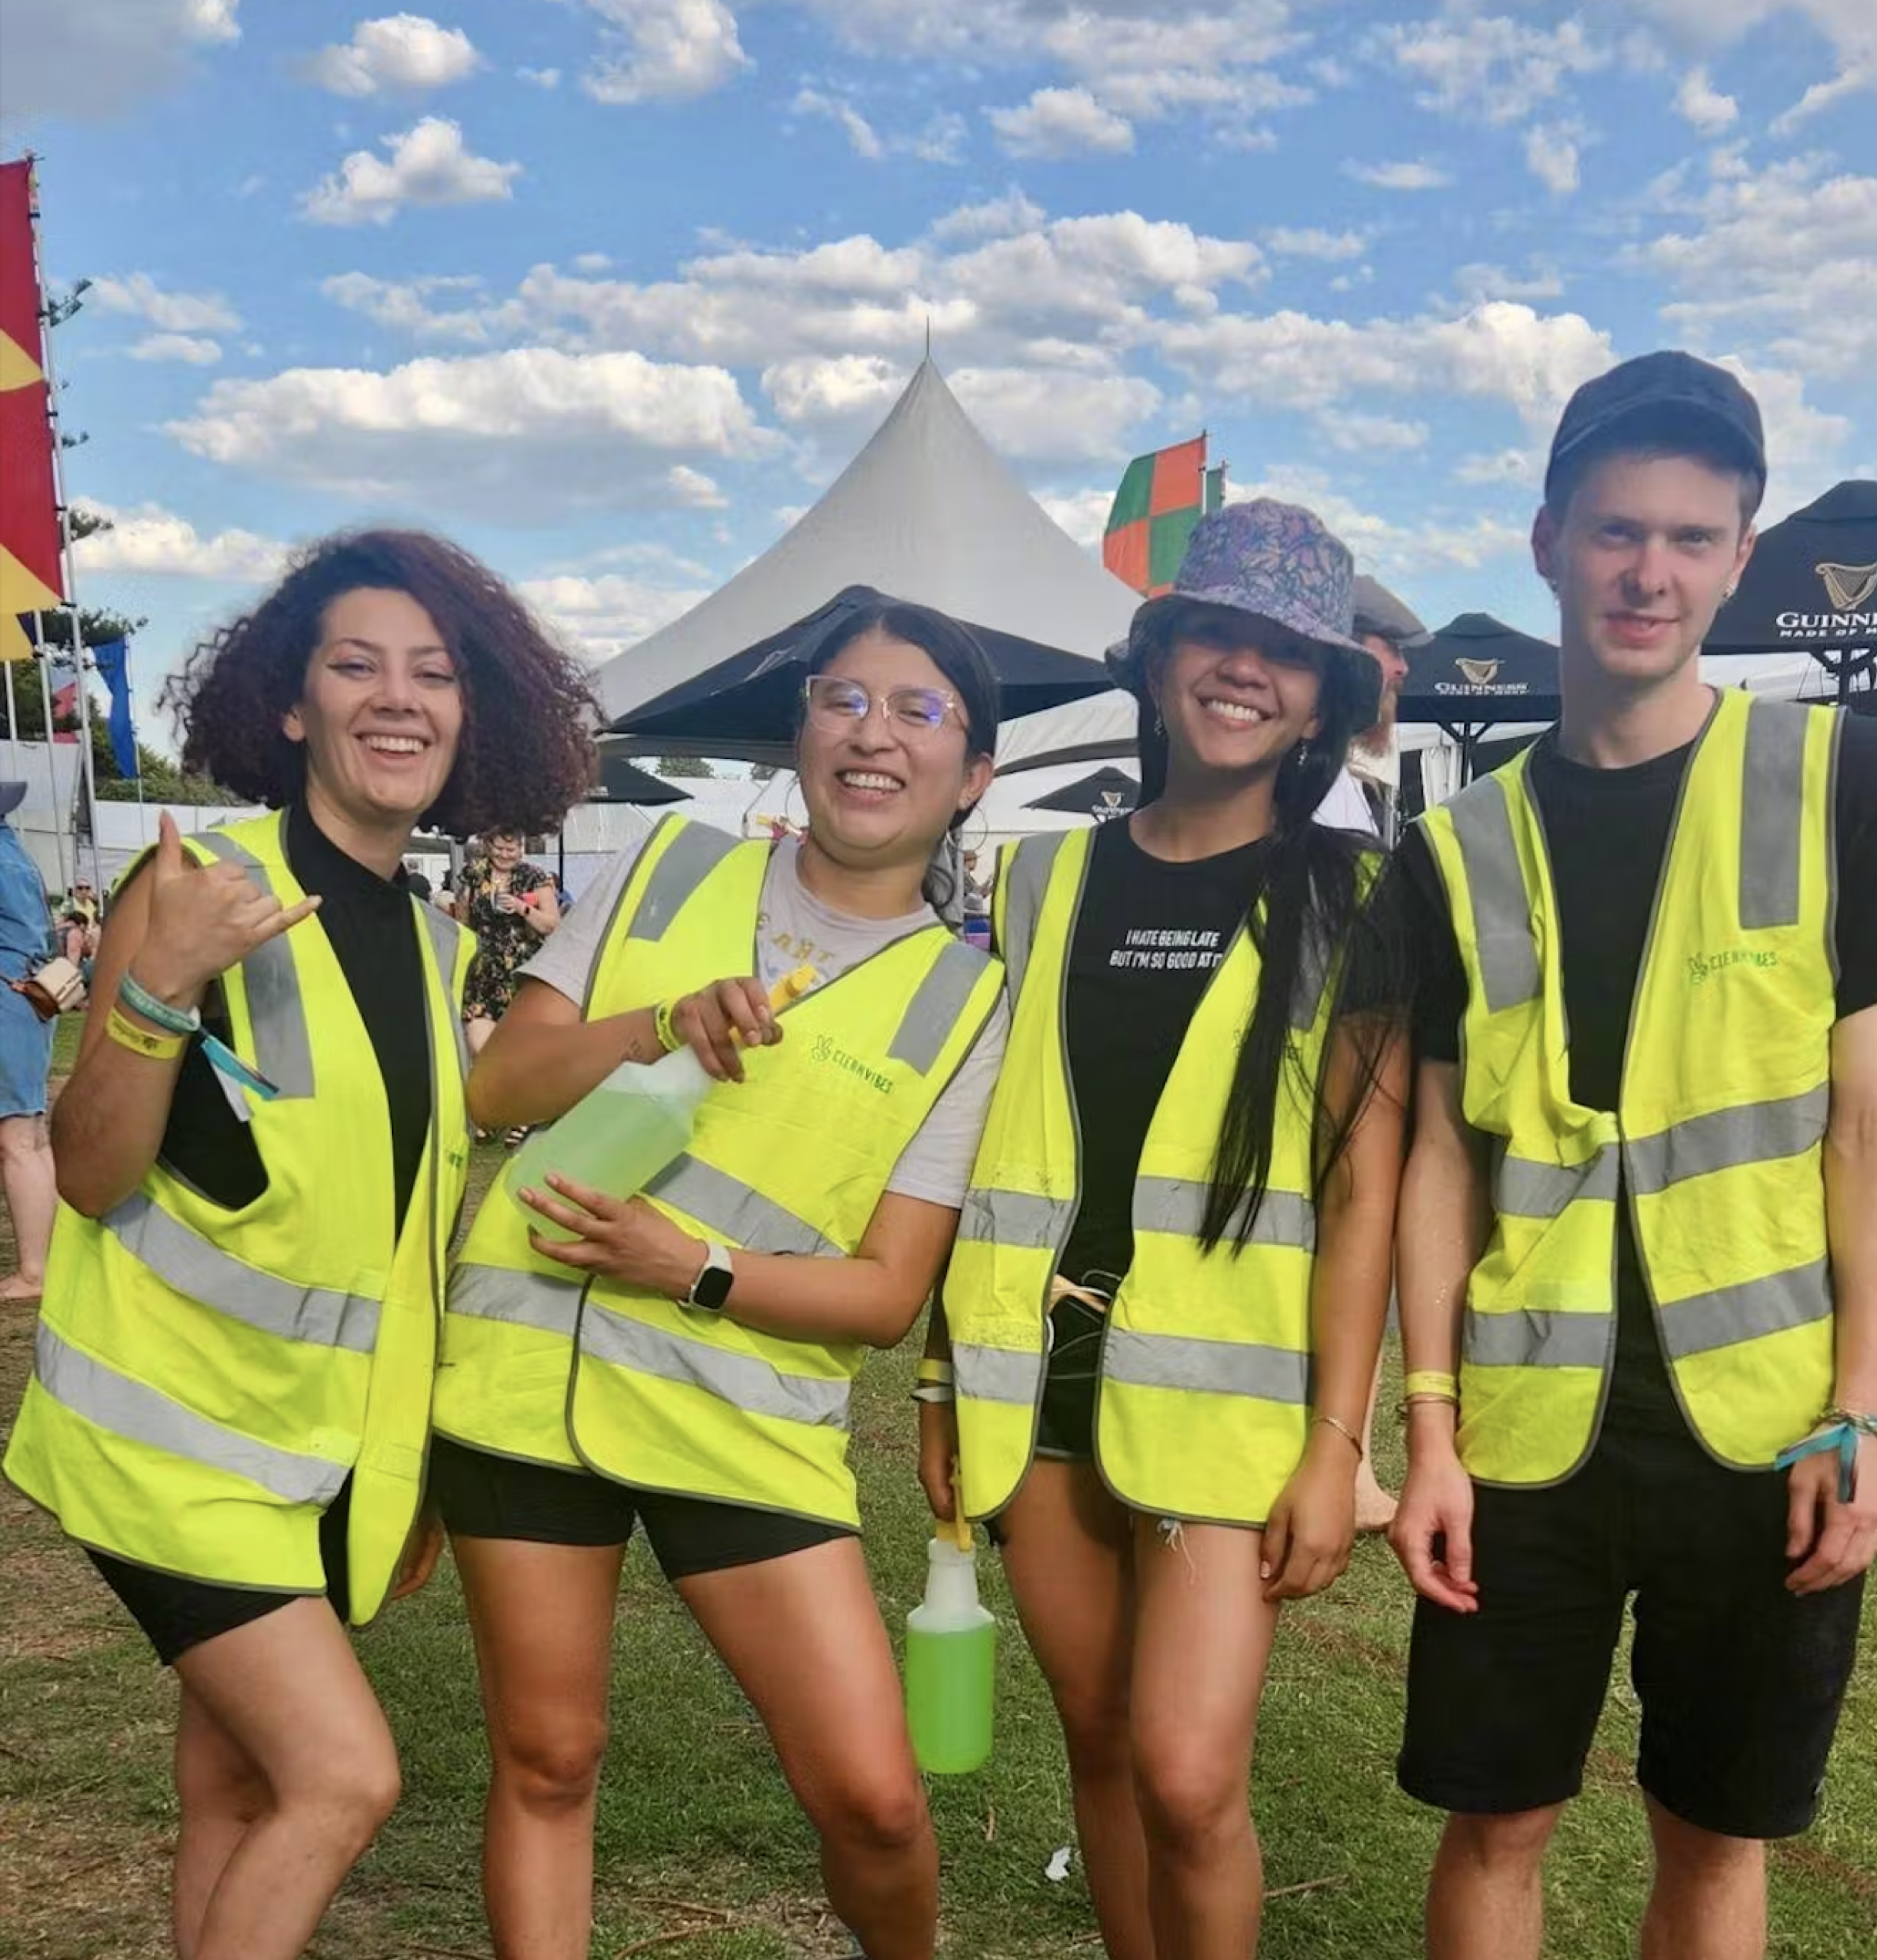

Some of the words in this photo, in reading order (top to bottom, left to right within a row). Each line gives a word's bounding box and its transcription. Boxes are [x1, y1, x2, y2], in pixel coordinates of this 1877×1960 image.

[1125, 929, 1133, 946] I
[1131, 929, 1159, 946] HATE
[1158, 930, 1192, 947] BEING
[1190, 930, 1221, 947] LATE
[1109, 950, 1134, 967] BUT
[1132, 951, 1151, 968] I'M
[1150, 951, 1166, 969] SO
[1166, 951, 1197, 969] GOOD
[1197, 951, 1213, 968] AT
